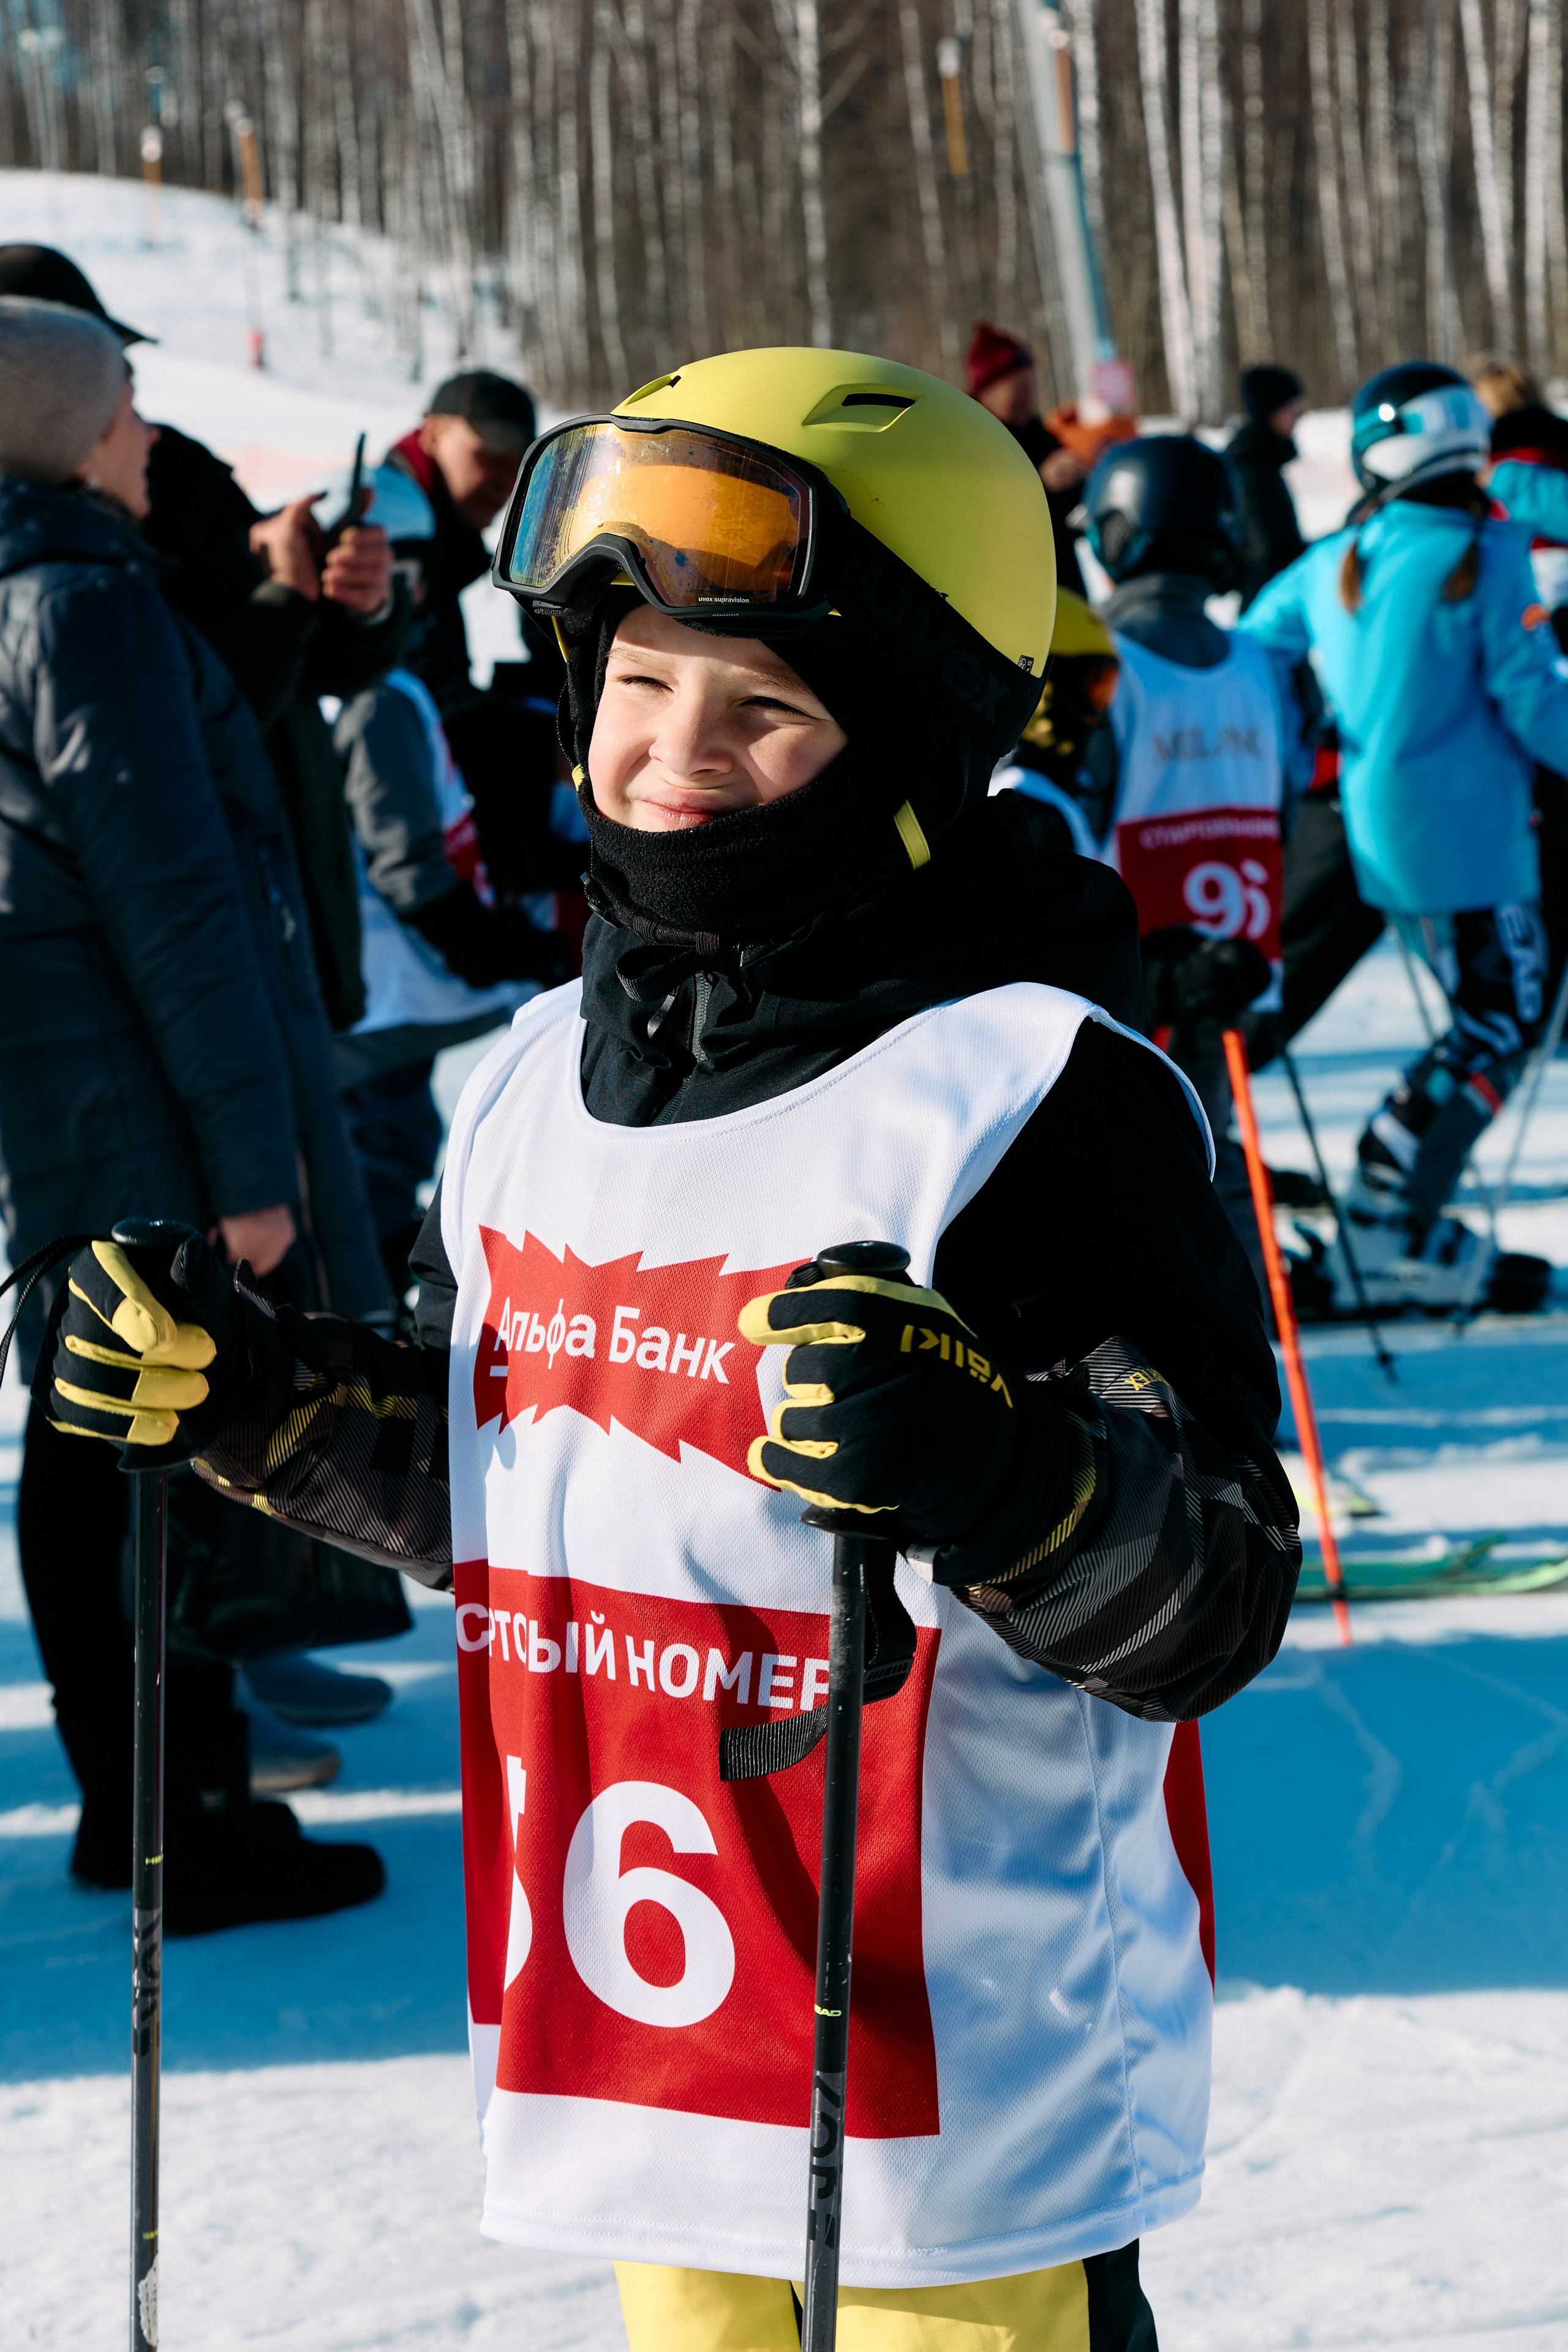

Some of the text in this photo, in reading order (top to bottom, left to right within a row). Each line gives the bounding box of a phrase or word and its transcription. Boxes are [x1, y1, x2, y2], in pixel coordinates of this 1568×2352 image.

[494, 1296, 736, 1384] Альфа Банк
[625, 1635, 829, 1711] НОМЕР
[814, 2003, 842, 2017] EAD
